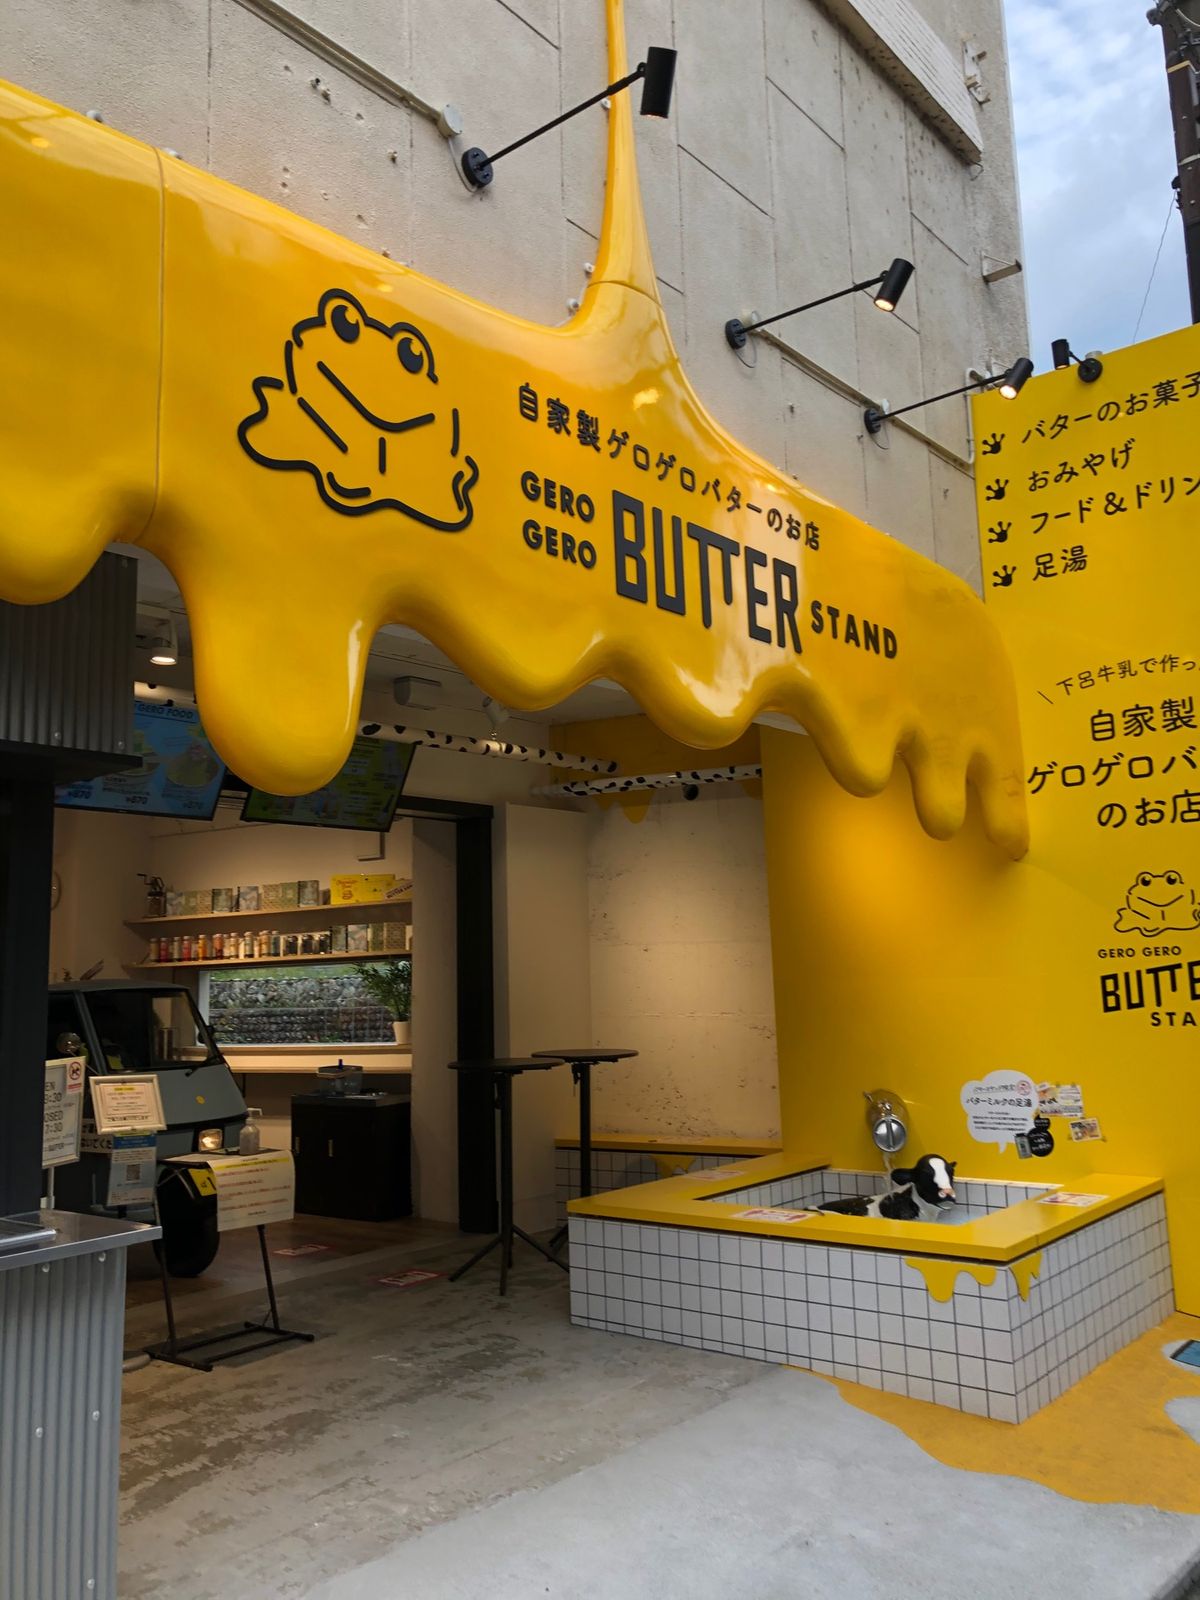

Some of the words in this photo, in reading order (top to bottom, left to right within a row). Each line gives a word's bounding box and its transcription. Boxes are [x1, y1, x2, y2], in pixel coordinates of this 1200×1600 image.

[1022, 371, 1200, 443] バターのお菓子
[518, 382, 821, 552] 自家製ゲロゲロバターのお店
[1028, 438, 1136, 492] おみやげ
[521, 470, 596, 523] GERO
[522, 519, 597, 569] GERO
[1032, 545, 1088, 581] 足湯
[612, 489, 802, 654] BUTTER
[811, 600, 898, 659] STAND
[1056, 654, 1200, 696] 下呂牛乳で作っ
[1090, 696, 1198, 742] 自家製
[1027, 745, 1197, 794] ゲロゲロバ
[1097, 789, 1200, 828] のお店
[1098, 948, 1136, 959] GERO
[1142, 945, 1182, 957] GERO
[1151, 1011, 1197, 1027] STA
